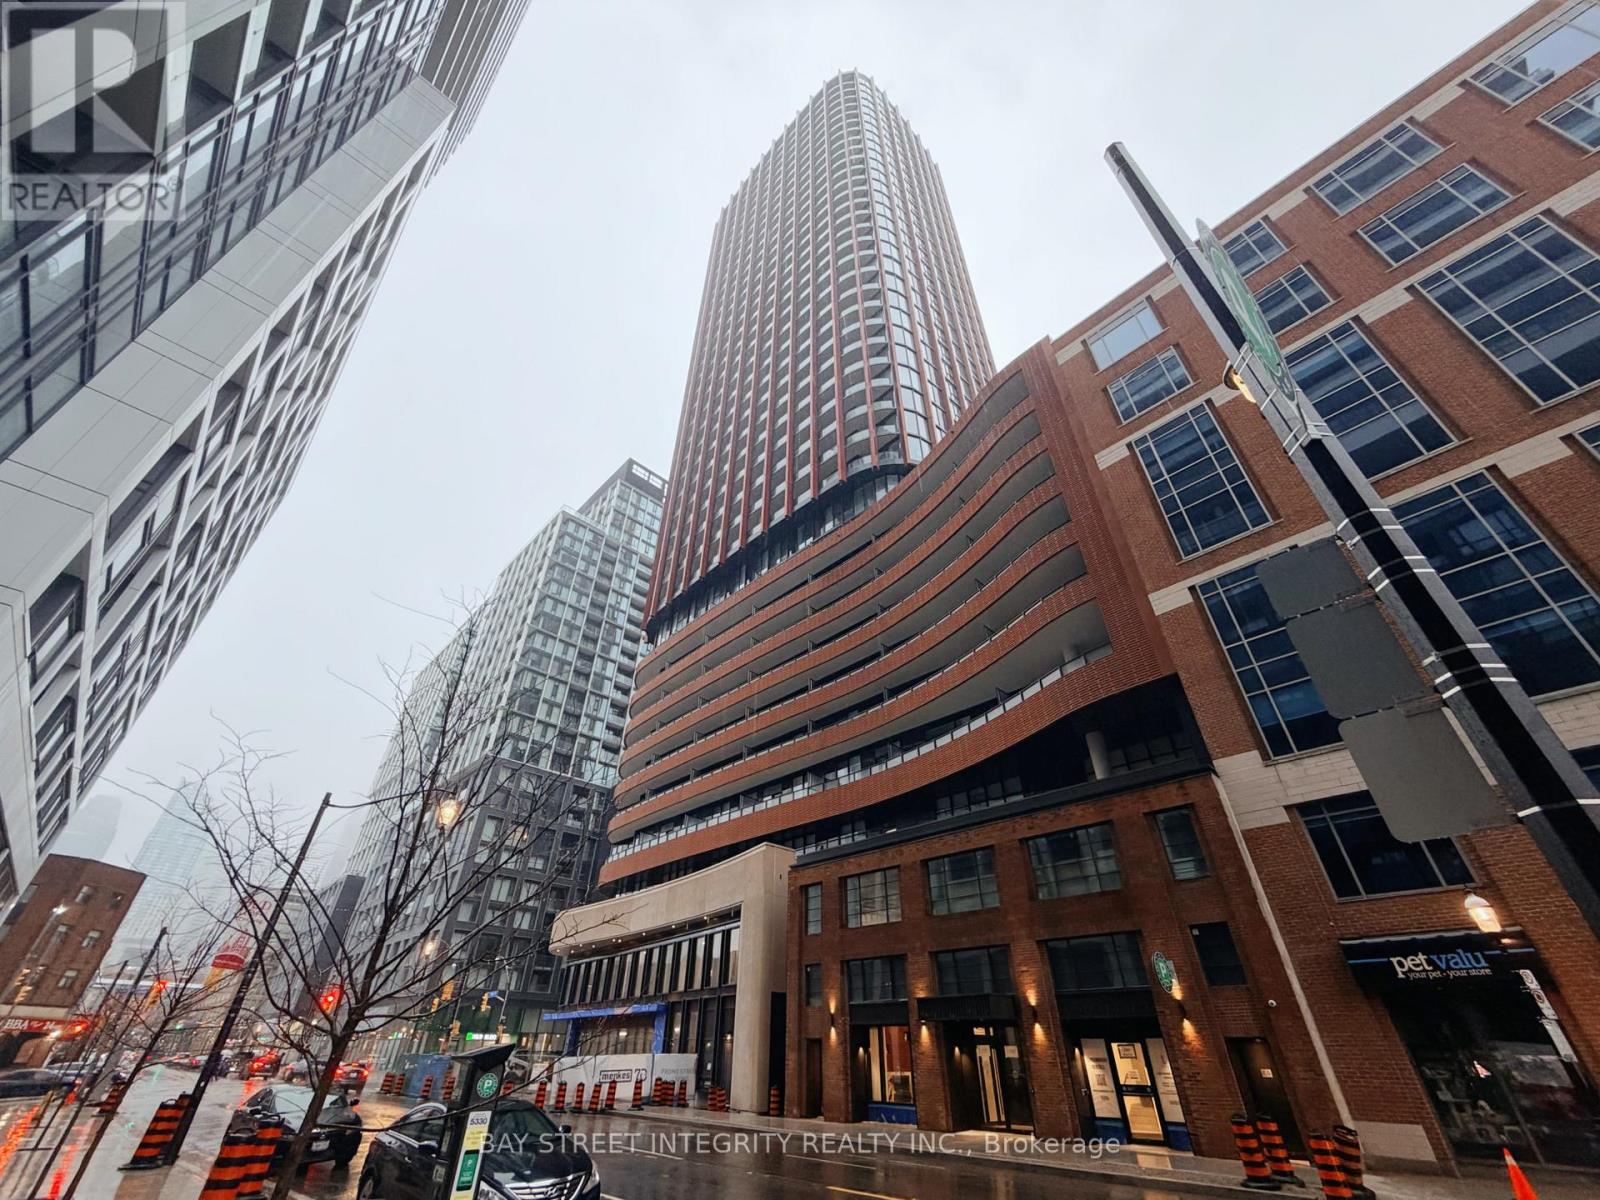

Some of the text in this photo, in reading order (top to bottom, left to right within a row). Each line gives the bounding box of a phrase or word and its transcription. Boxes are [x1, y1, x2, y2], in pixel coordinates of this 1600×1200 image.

[1389, 948, 1489, 978] pet valu
[1408, 968, 1492, 980] your pet your store
[601, 1071, 631, 1081] menkes
